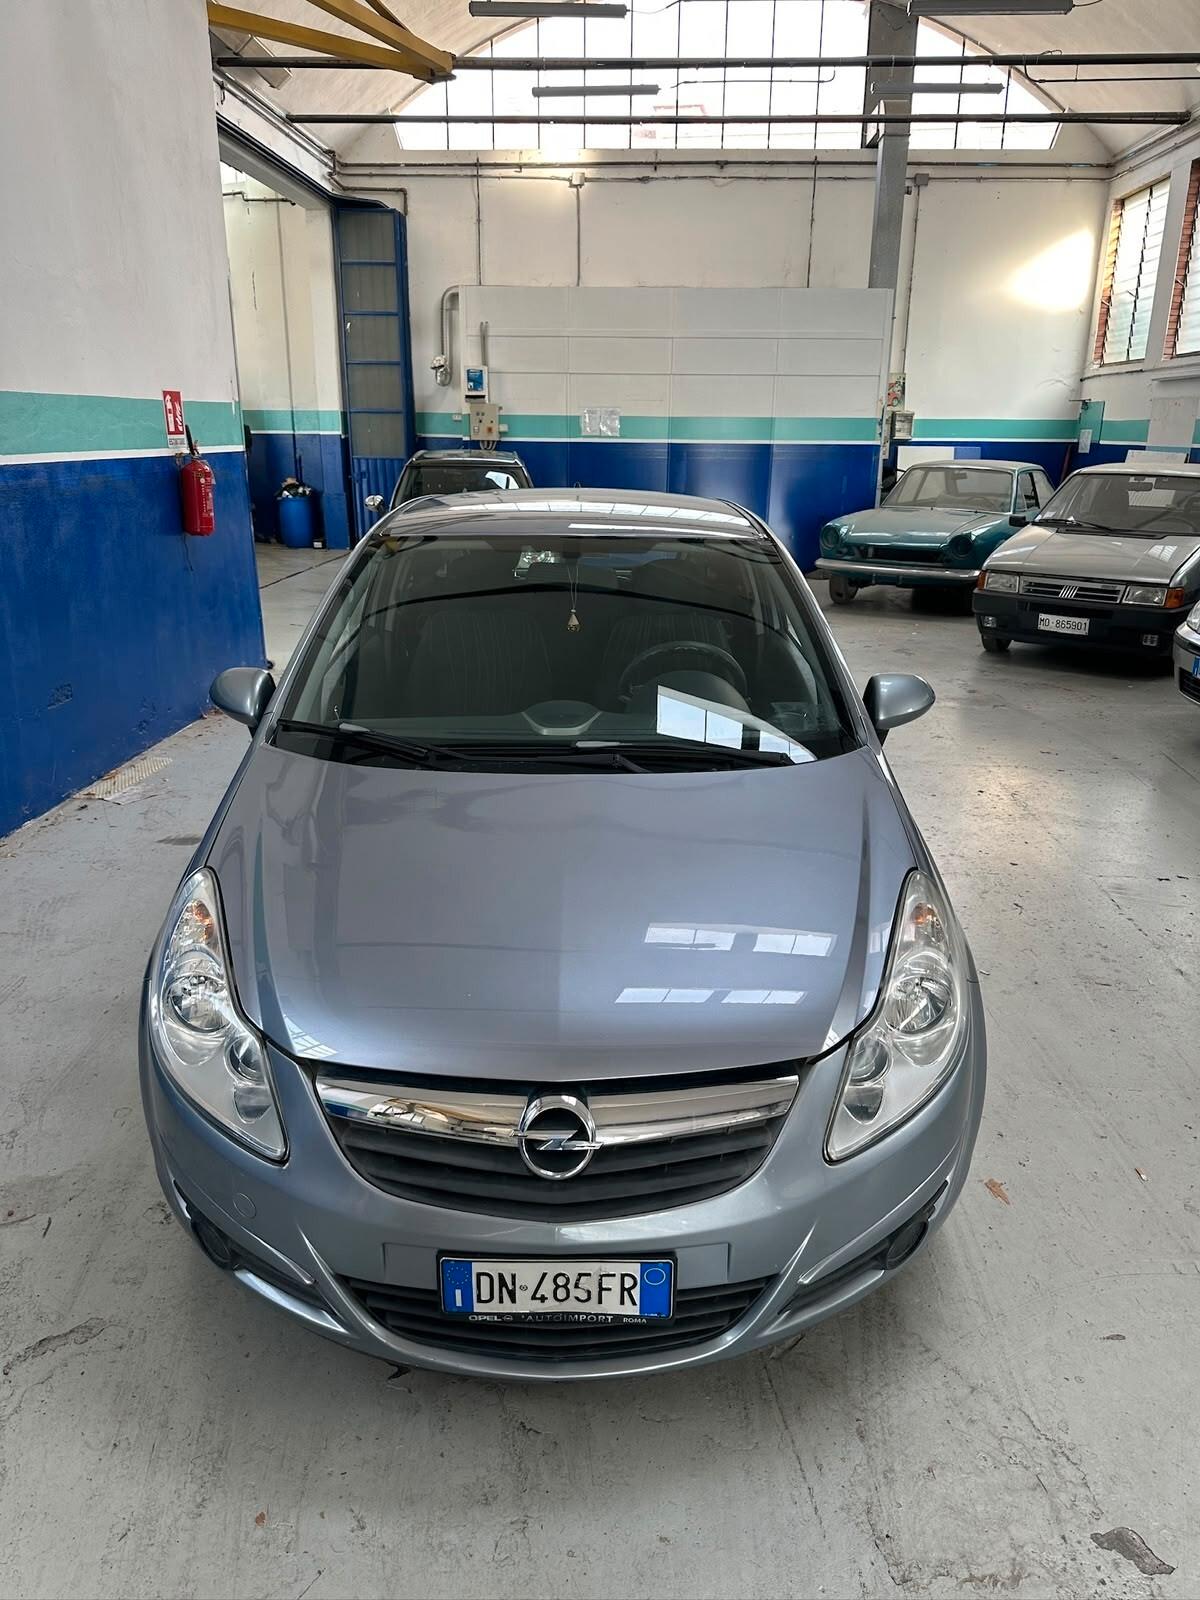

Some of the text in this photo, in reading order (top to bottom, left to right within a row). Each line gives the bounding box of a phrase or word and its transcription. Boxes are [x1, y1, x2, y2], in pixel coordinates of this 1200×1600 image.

[1040, 617, 1087, 632] MO 865901
[475, 1271, 638, 1307] DN 485FR
[468, 1314, 502, 1322] OPEL
[623, 1317, 648, 1325] ROMA
